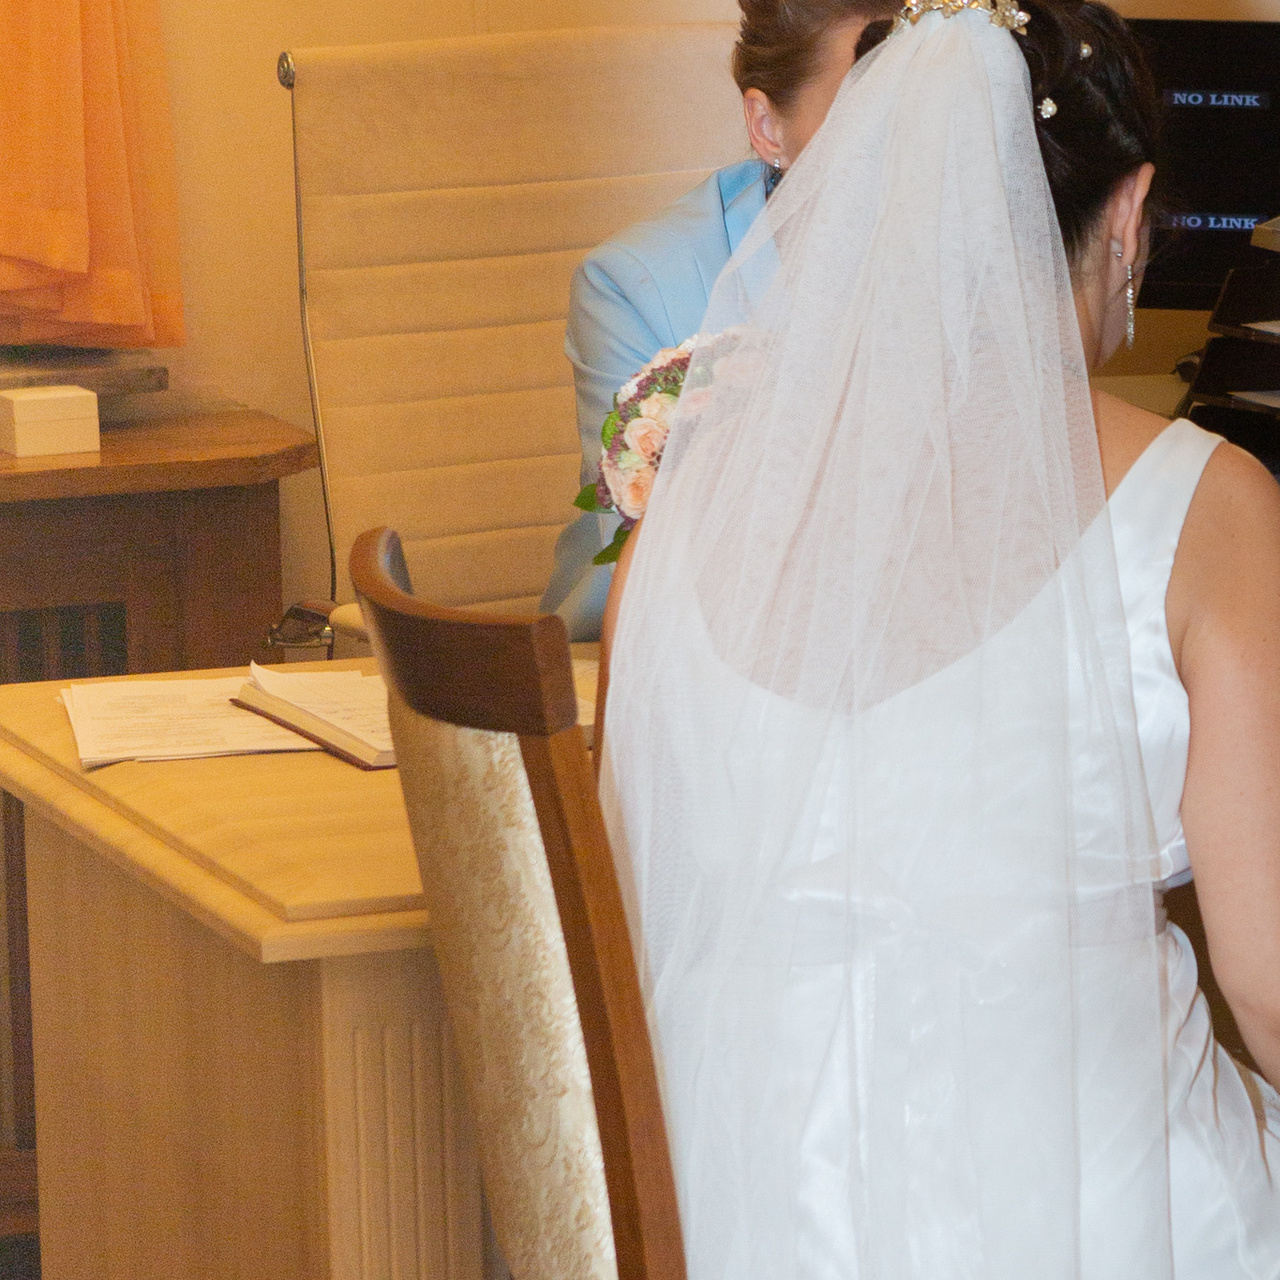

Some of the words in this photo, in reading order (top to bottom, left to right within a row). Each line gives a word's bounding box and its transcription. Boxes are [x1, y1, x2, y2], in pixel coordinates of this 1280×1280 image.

[1173, 93, 1203, 105] NO
[1210, 94, 1260, 106] LINK
[1208, 217, 1258, 229] LINK
